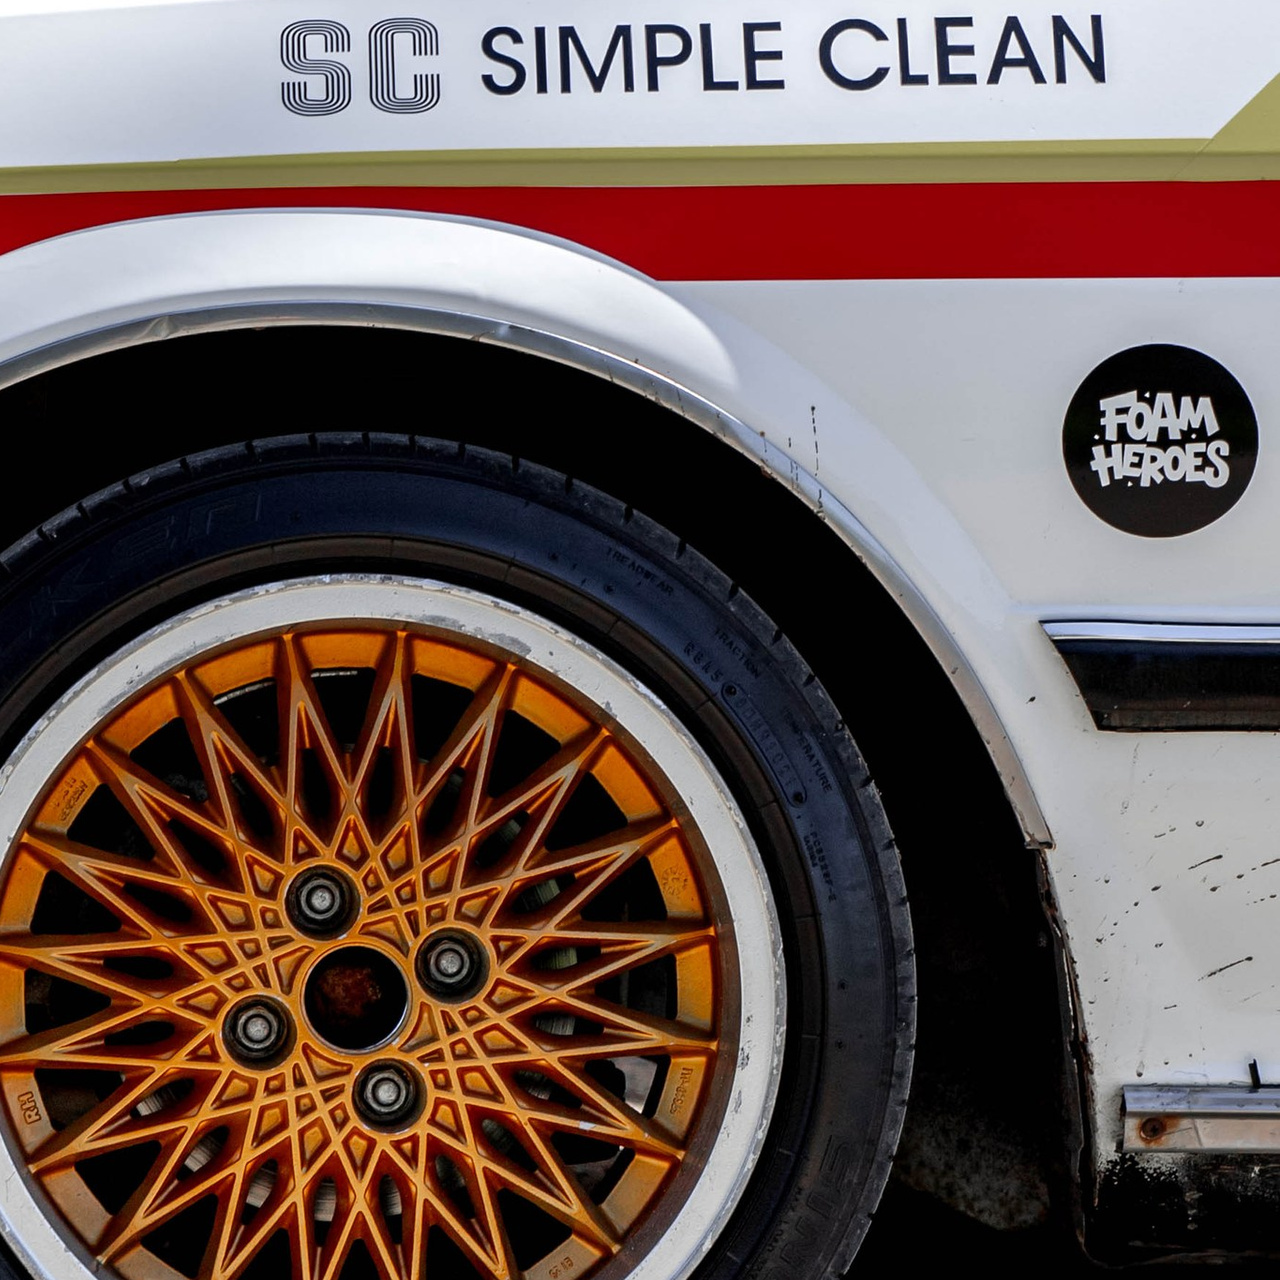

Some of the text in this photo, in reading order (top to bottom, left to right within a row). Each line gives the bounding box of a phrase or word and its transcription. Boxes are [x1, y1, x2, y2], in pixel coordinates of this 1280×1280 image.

[280, 14, 1106, 116] SC SIMPLE CLEAN
[1098, 389, 1221, 442] FOAM
[1089, 440, 1231, 488] HEROES
[607, 546, 675, 597] TREADWEAR
[713, 628, 763, 679] TRACTION
[15, 1089, 43, 1126] RH
